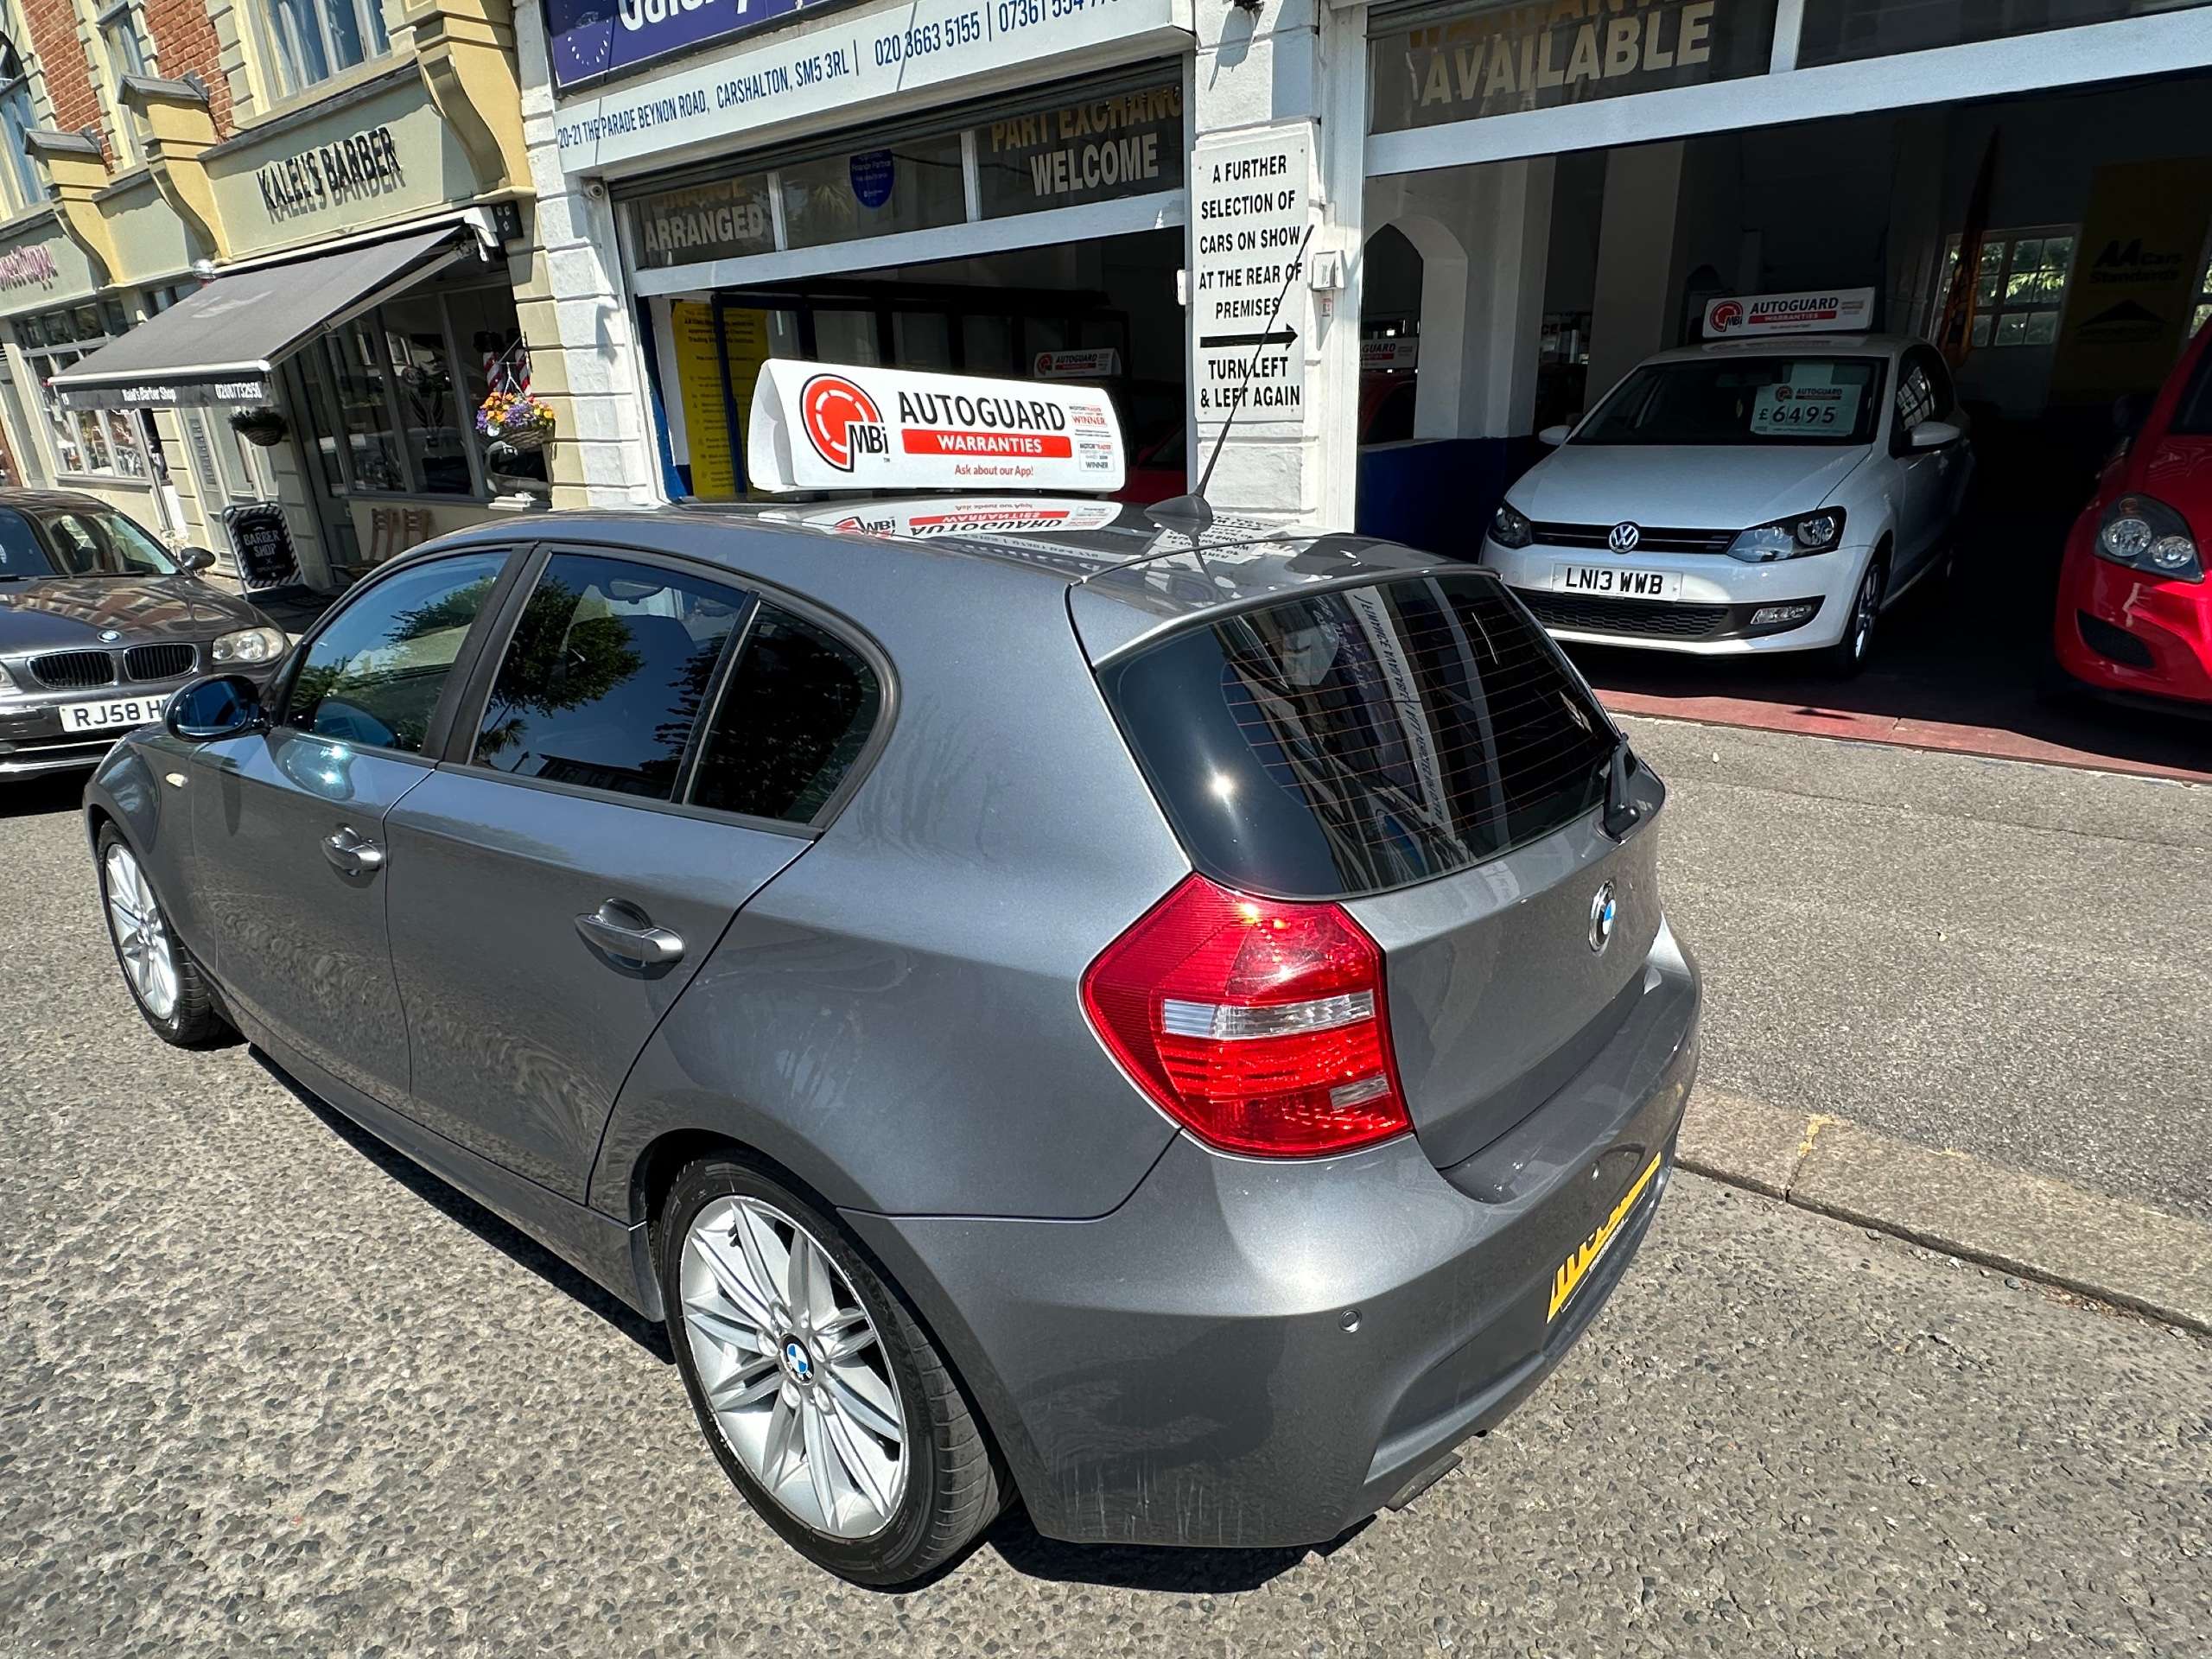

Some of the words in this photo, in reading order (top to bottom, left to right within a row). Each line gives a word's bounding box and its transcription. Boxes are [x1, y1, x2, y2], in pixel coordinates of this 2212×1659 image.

[1421, 1, 1714, 106] AVAILABLE
[557, 124, 582, 149] 20-21
[582, 118, 601, 141] THE
[601, 108, 637, 137] PARADE
[638, 98, 677, 129] BEYNON
[678, 90, 710, 118] ROAD,
[716, 67, 793, 109] CARSHALTON,
[794, 56, 822, 87] SM5
[824, 48, 850, 79] 3RL
[874, 34, 901, 67] 020
[905, 23, 941, 60] 3663
[945, 10, 980, 48] 5155
[998, 0, 1046, 33] 07361
[992, 111, 1047, 152] PART
[1059, 87, 1183, 139] EXCHANG
[320, 127, 401, 192] BARBER
[1030, 132, 1159, 196] WELCOME
[1212, 164, 1221, 184] A
[1225, 155, 1287, 181] FURTHER
[1201, 193, 1273, 219] SELECTION
[1278, 190, 1296, 211] OF
[645, 203, 765, 252] ARRANGED
[1200, 232, 1233, 255] CARS
[1237, 230, 1256, 251] ON
[1261, 226, 1300, 250] SHOW
[1199, 270, 1214, 290] AT
[1217, 268, 1243, 289] THE
[1246, 264, 1281, 285] REAR
[1285, 262, 1303, 283] OF
[1216, 297, 1280, 320] PREMISES
[1750, 297, 1839, 315] AUTOGUARD
[1764, 313, 1819, 321] WARRANTIES
[1208, 359, 1248, 379] TURN
[1253, 357, 1288, 378] LEFT
[1200, 388, 1210, 408] &
[1215, 386, 1249, 408] LEFT
[1253, 385, 1300, 407] AGAIN
[898, 391, 1065, 431] AUTOGUARD
[1071, 415, 1105, 425] WINNER
[937, 435, 1042, 454] WARRANTIES
[955, 464, 970, 475] Ask
[974, 465, 998, 475] about
[1014, 465, 1033, 477] App!
[243, 530, 281, 546] BARBER
[253, 543, 276, 557] SHOP
[1566, 567, 1613, 591] LN13
[1620, 571, 1663, 594] WWB
[74, 703, 141, 728] RJ58
